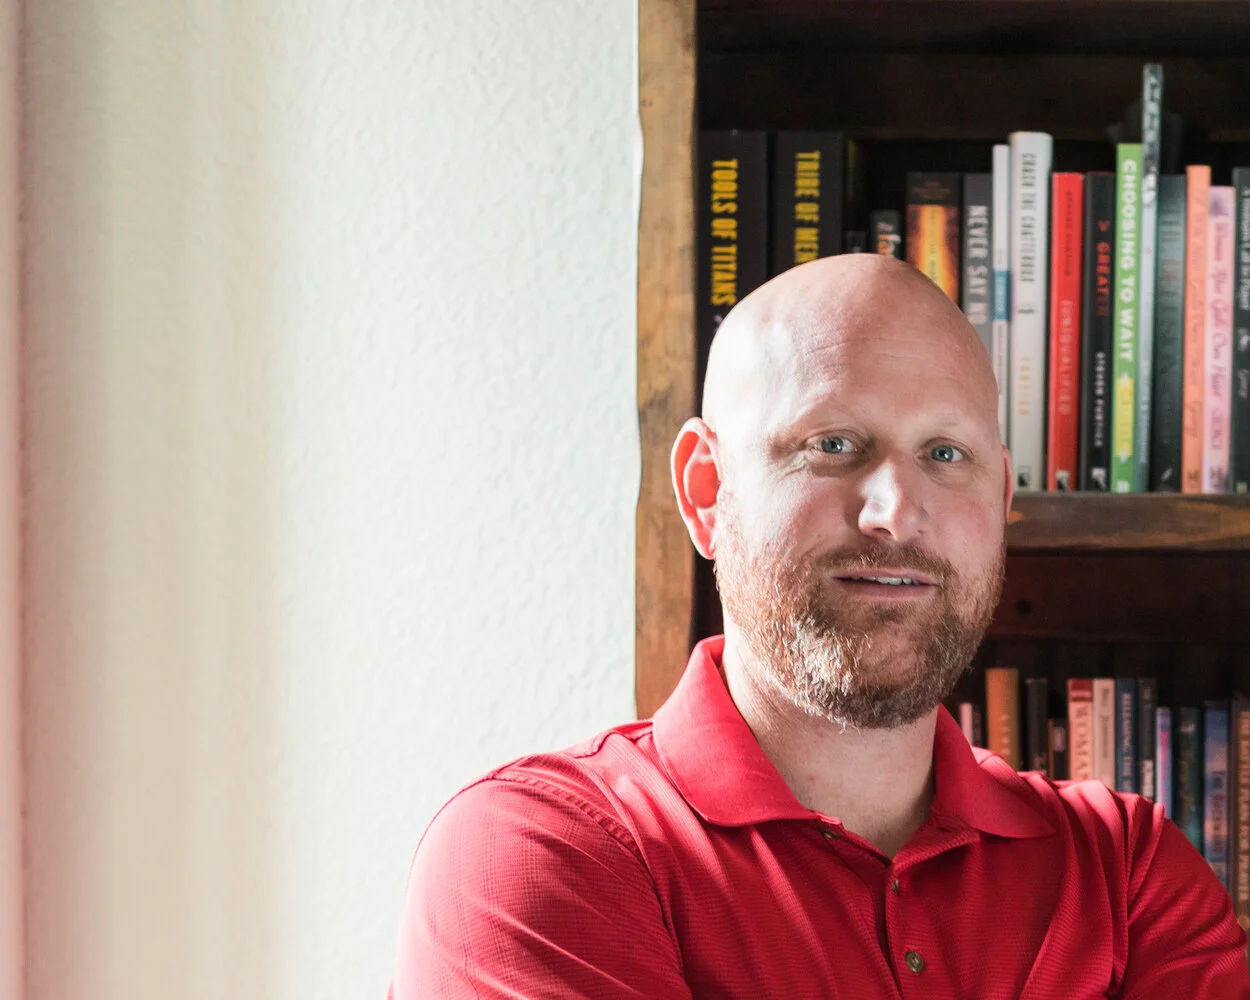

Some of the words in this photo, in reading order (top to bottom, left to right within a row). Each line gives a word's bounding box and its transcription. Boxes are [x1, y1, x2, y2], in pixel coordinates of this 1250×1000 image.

[711, 159, 738, 213] TOOLS
[795, 151, 820, 197] TRIBE
[711, 218, 738, 239] OF
[795, 202, 819, 221] OF
[967, 205, 988, 257] NEVER
[1120, 160, 1138, 271] CHOOSING
[711, 244, 737, 305] TITANS
[967, 266, 987, 295] SAY
[1119, 275, 1136, 303] TO
[1118, 308, 1136, 363] WAIT
[1238, 787, 1250, 822] PLAN
[1238, 825, 1250, 851] FOR
[1237, 855, 1250, 902] PRAYER
